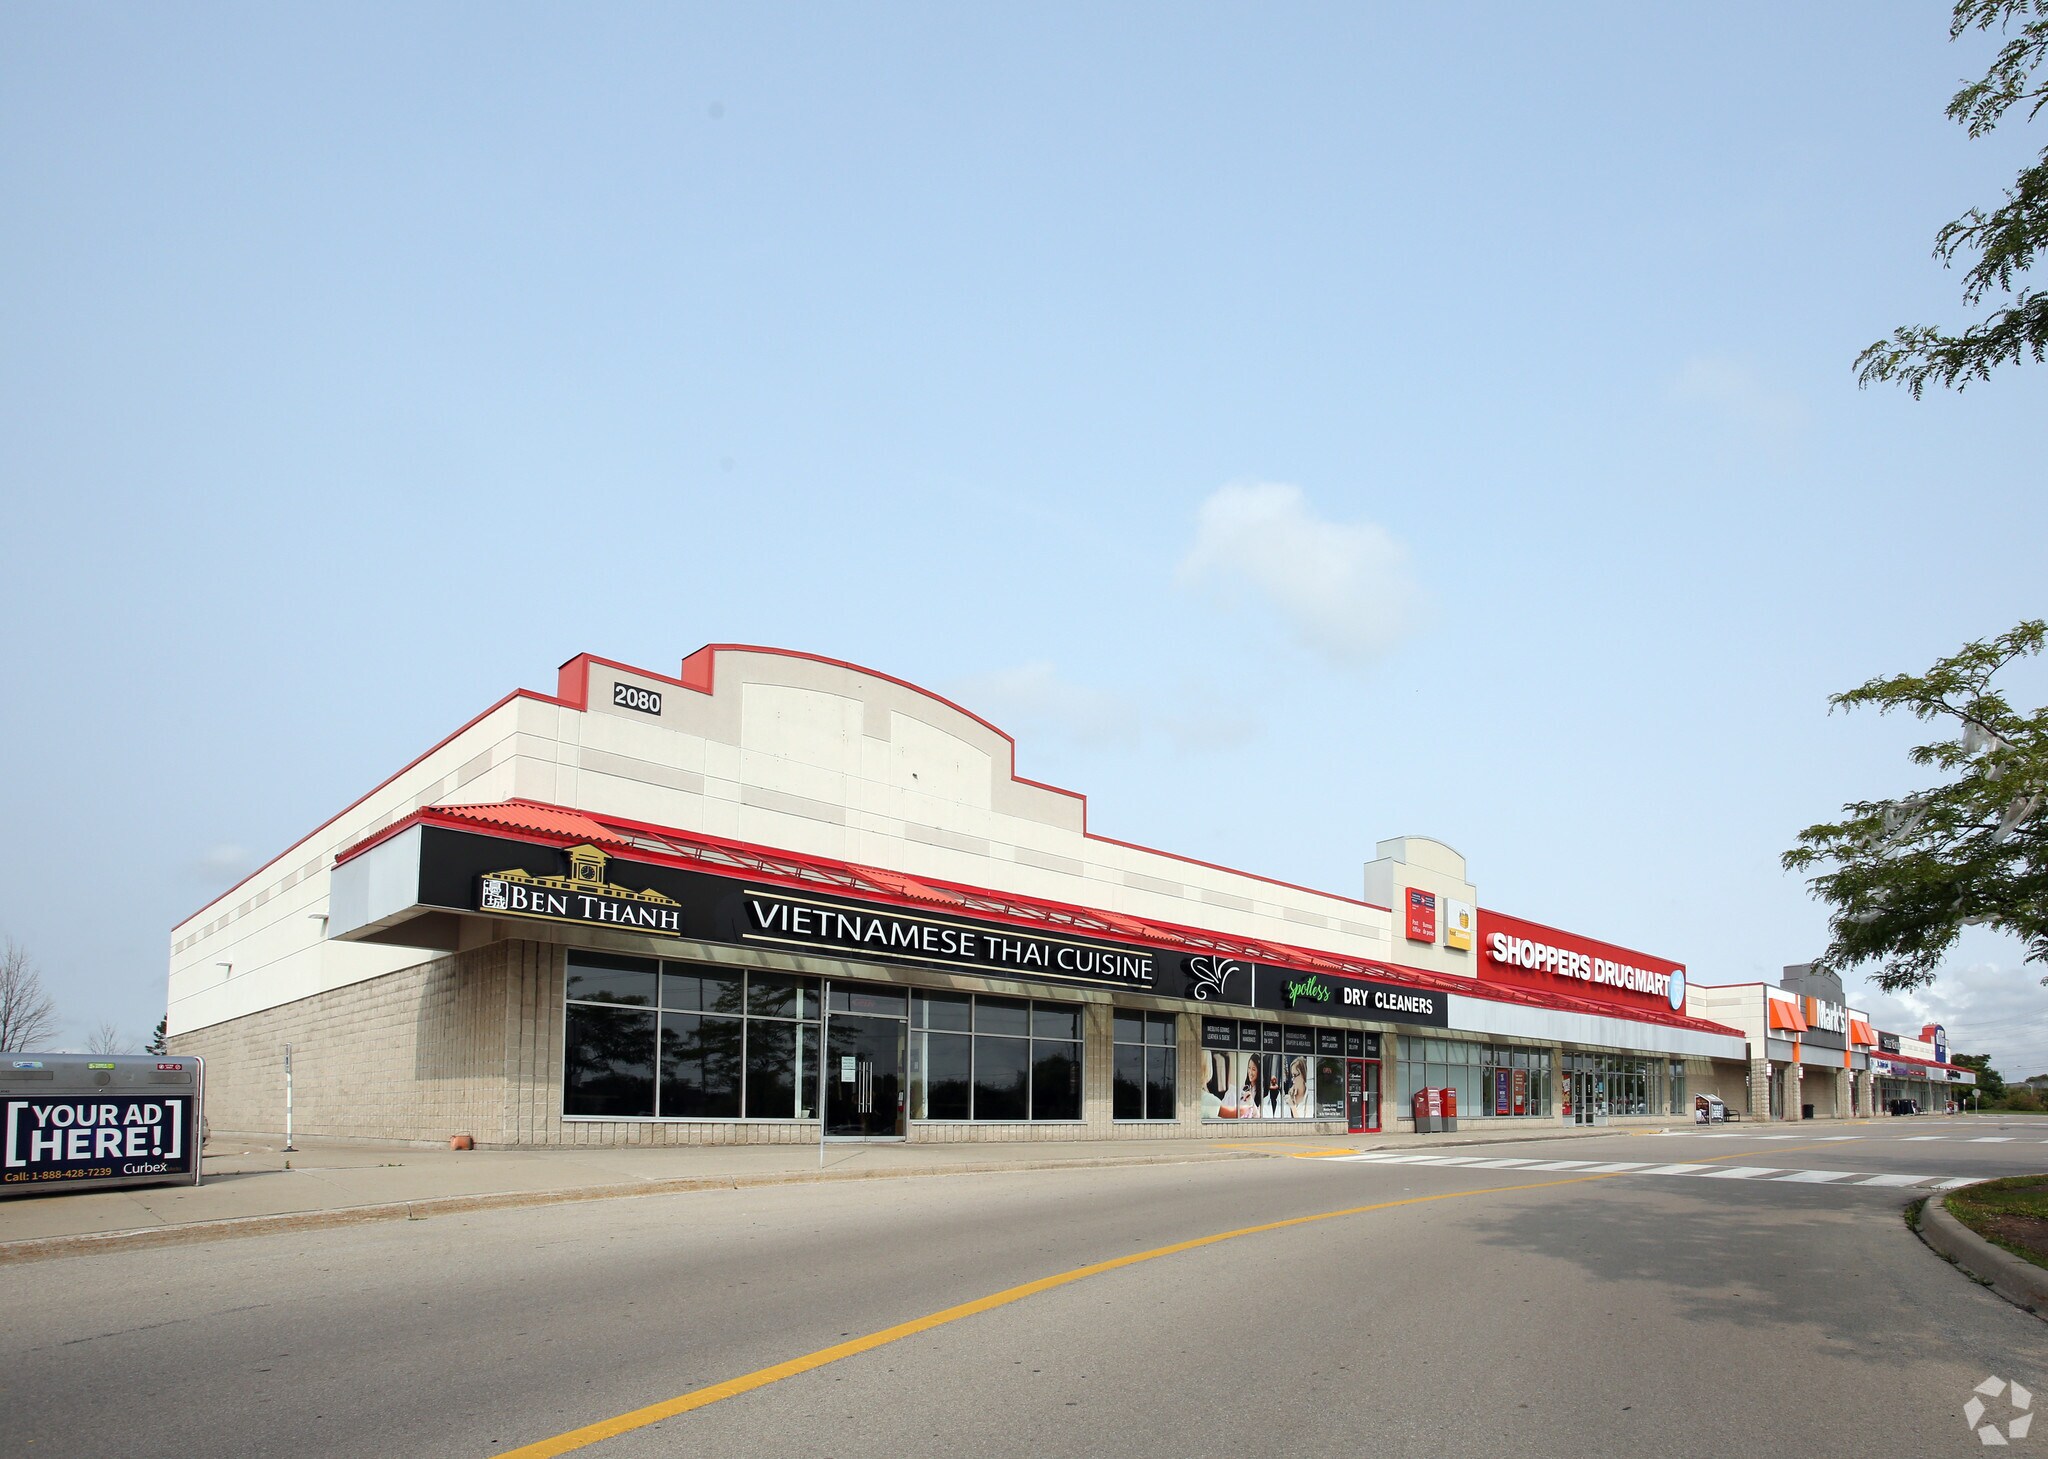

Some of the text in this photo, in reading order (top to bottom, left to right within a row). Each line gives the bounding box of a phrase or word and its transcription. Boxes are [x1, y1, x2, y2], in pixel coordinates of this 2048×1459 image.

[615, 685, 660, 712] 2080
[510, 885, 679, 930] BEN THANH
[752, 900, 1153, 980] VIETNAMESE THAI CUISINE
[1492, 932, 1591, 981] SHOPPERS
[1343, 987, 1433, 1015] DRY CLEANERS
[1816, 998, 1845, 1034] Mark's
[32, 1104, 162, 1128] YOUR AD
[31, 1126, 162, 1162] HERE!
[5, 1167, 112, 1182] Call: 1-888-428-7239
[123, 1161, 168, 1175] Curbex
